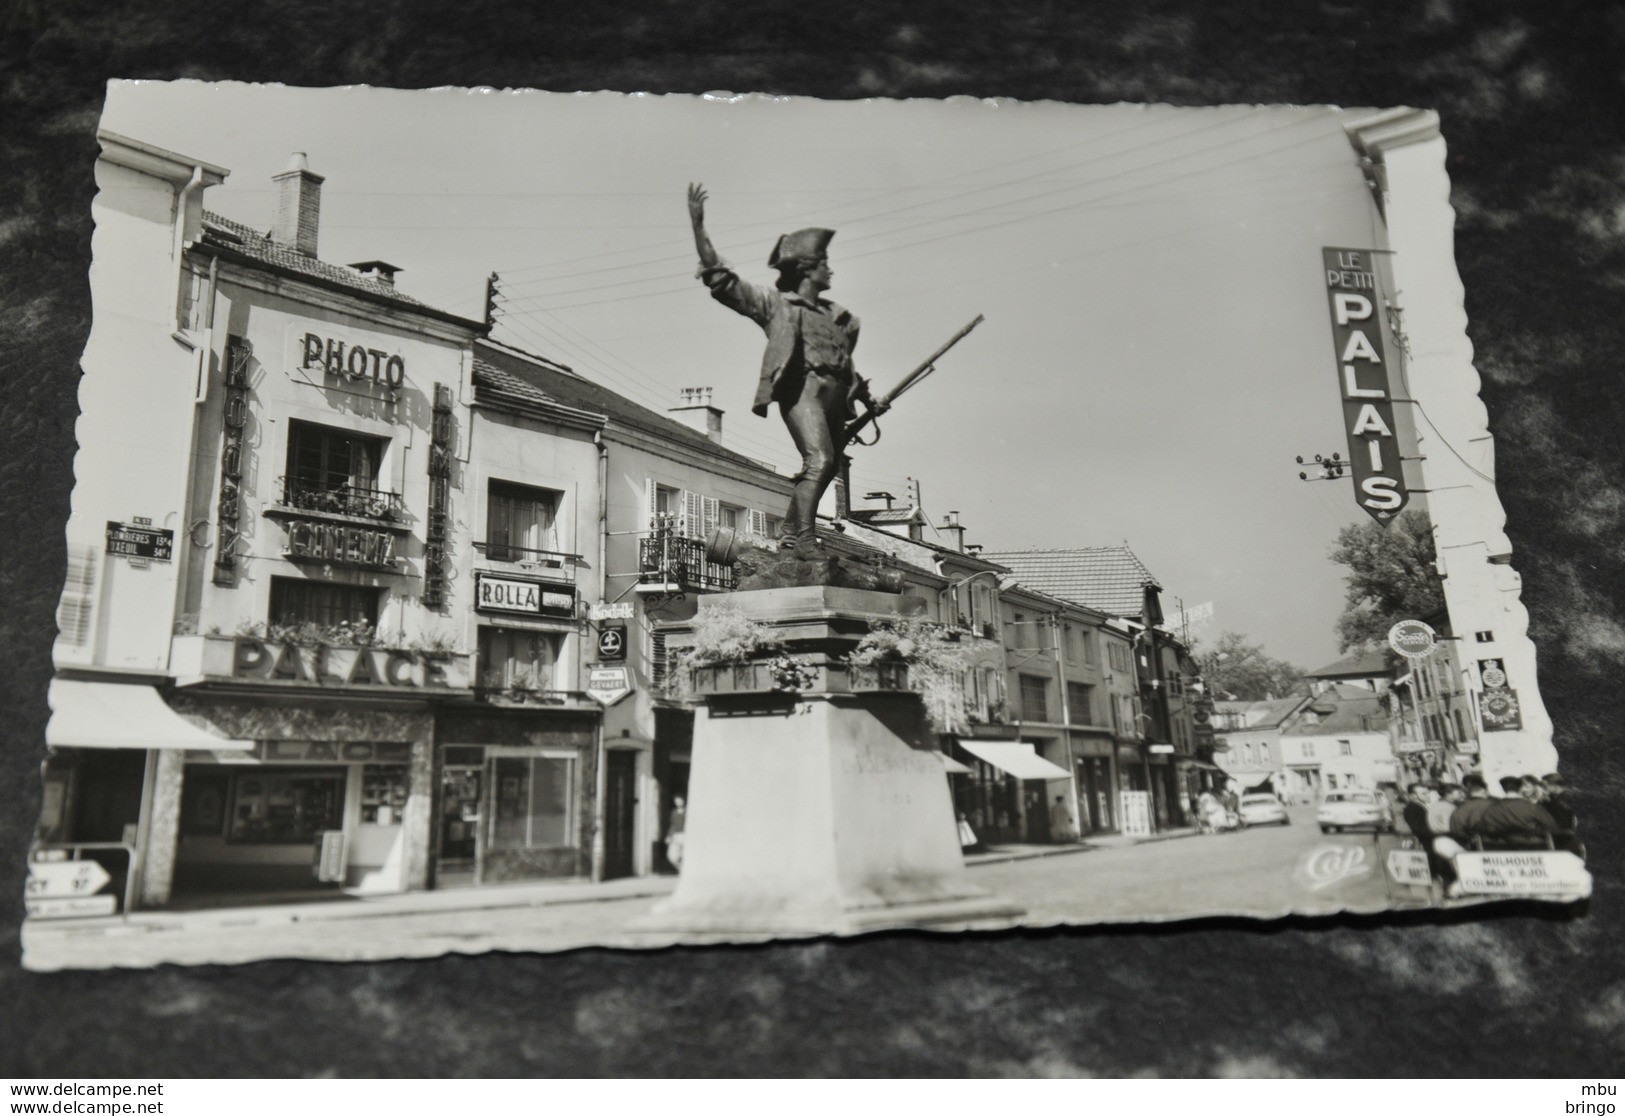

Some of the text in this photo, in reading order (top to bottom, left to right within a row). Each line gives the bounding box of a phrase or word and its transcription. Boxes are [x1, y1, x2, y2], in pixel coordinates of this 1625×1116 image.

[1338, 251, 1361, 270] LE
[1327, 269, 1374, 289] PETIT
[302, 331, 405, 390] PHOTO
[1333, 292, 1402, 510] PALAIS
[287, 520, 399, 568] CINEMA
[482, 583, 538, 608] ROLLA
[589, 602, 634, 620] Kodak
[235, 637, 450, 688] PALACE
[591, 680, 625, 689] GEVAERT
[1482, 856, 1544, 867] MULHOUSE
[1483, 868, 1504, 878] VAL
[1465, 878, 1508, 889] COLMAR
